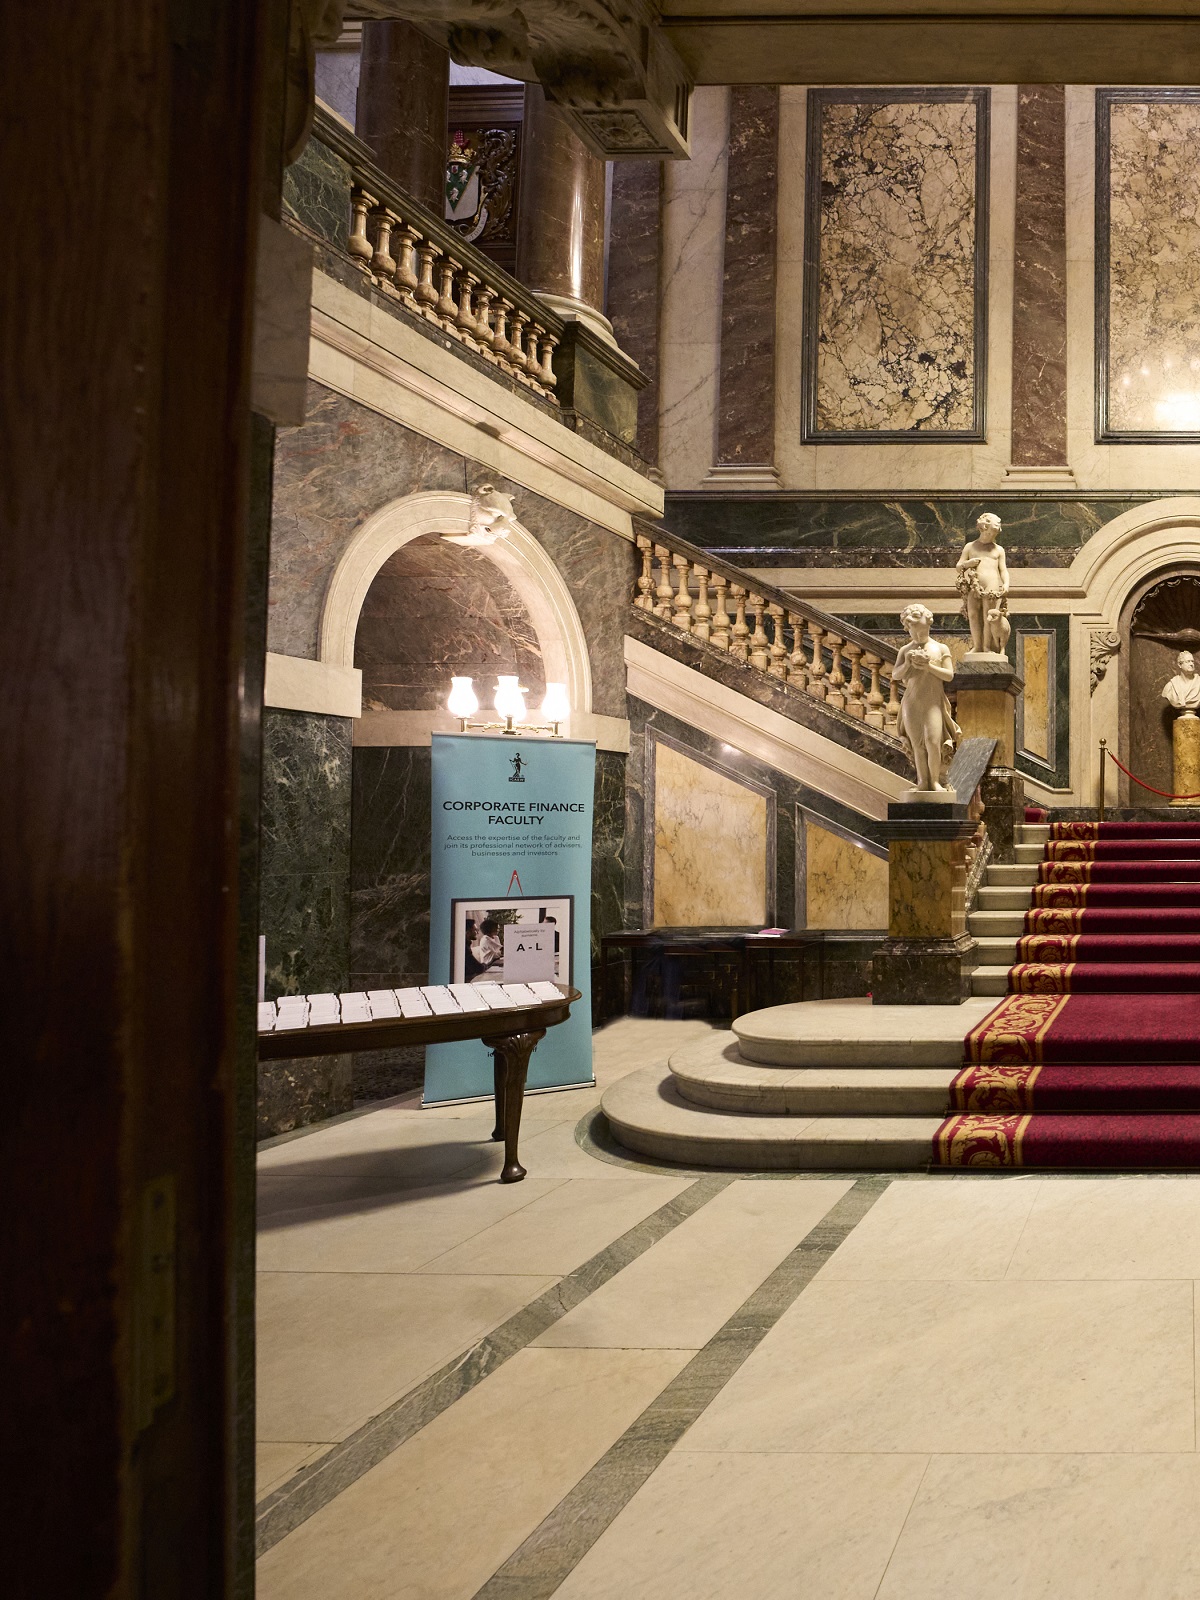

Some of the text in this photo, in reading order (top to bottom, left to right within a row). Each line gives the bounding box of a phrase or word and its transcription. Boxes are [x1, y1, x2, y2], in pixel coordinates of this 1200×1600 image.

[443, 801, 585, 812] CORPORATE FINANCE
[488, 816, 544, 825] FACULTY
[443, 842, 458, 850] join
[470, 842, 514, 850] professional
[516, 943, 526, 952] A
[535, 942, 543, 951] L
